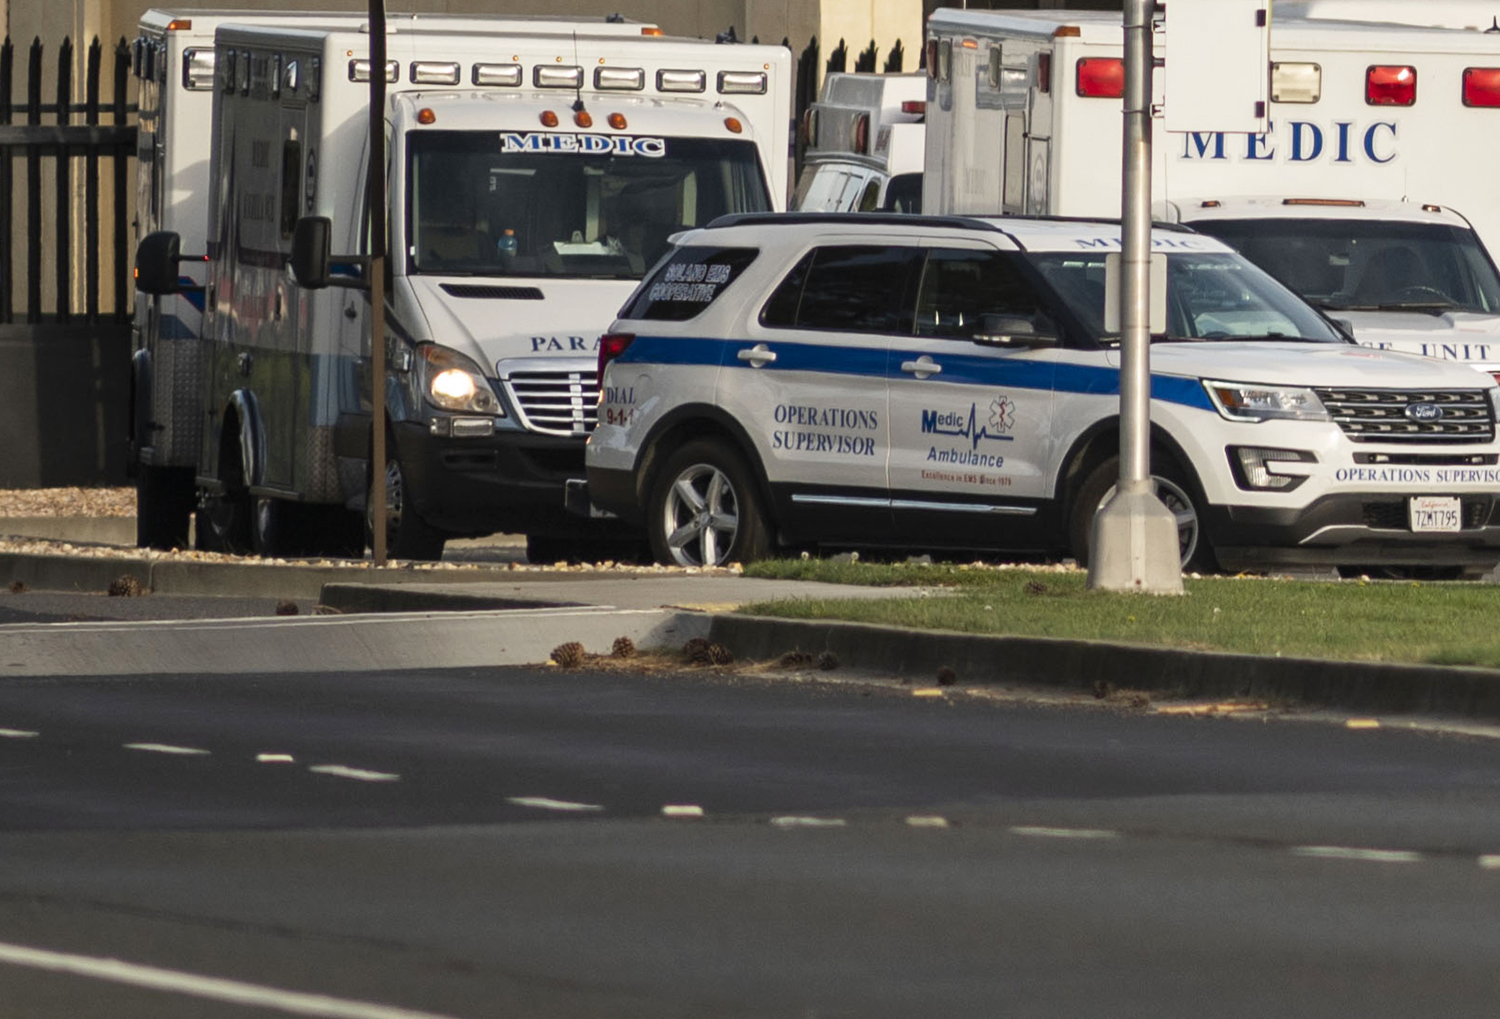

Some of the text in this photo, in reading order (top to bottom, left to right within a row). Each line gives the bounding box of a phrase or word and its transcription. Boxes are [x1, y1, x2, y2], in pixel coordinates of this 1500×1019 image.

[500, 133, 666, 158] MEDIC
[1181, 122, 1397, 164] MEDIC
[664, 263, 732, 283] SOLANO EMS
[649, 282, 717, 302] COOPERATIVE
[1420, 343, 1491, 360] UNIT
[607, 386, 636, 405] DIAL
[774, 404, 878, 430] OPERATIONS
[922, 409, 964, 433] Medic
[1415, 405, 1437, 418] Ford
[772, 430, 876, 456] SUPERVISOR
[927, 446, 1004, 468] Ambulance
[1335, 468, 1430, 482] OPERATIONS
